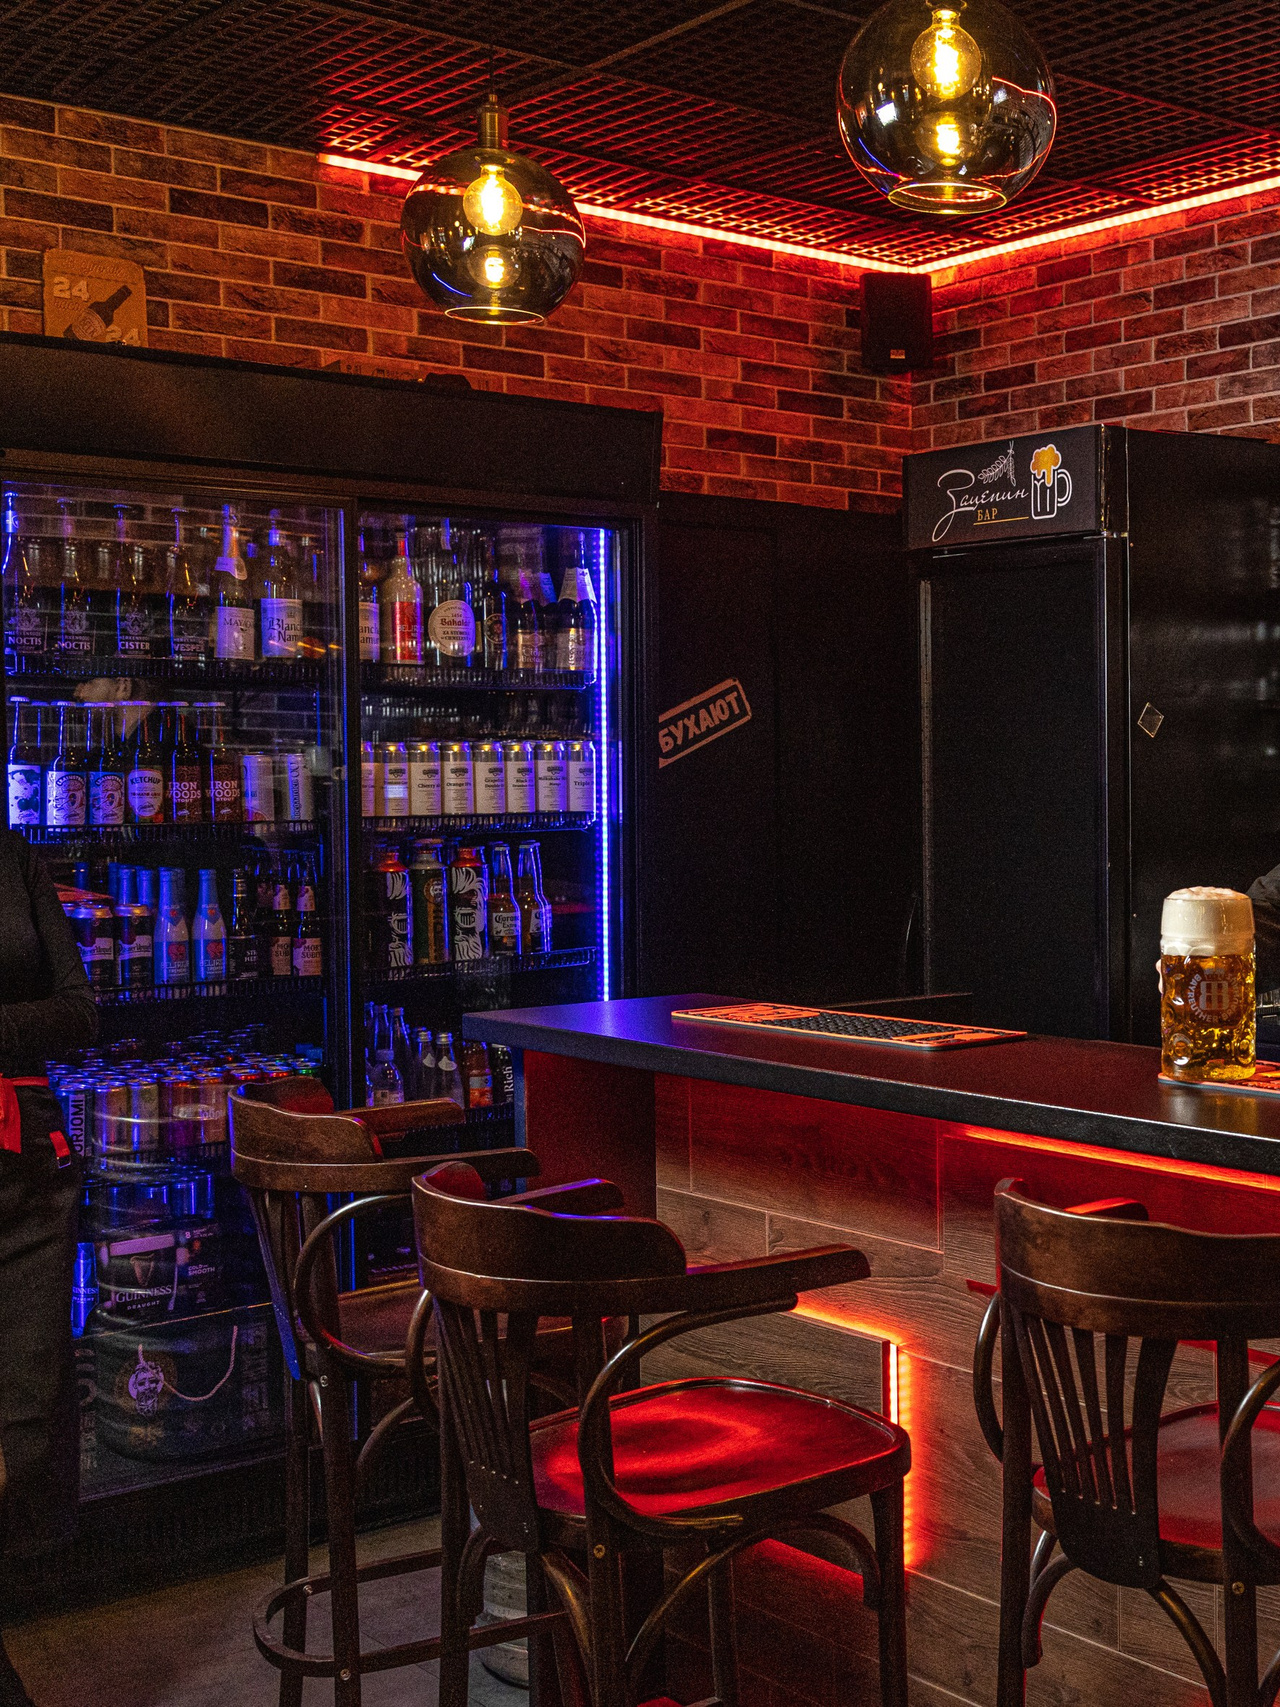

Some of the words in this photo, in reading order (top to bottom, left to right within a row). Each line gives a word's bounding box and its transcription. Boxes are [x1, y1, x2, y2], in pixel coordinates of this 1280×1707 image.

[53, 276, 90, 302] 24
[977, 508, 998, 521] БАР
[8, 636, 42, 646] NOCTIS
[168, 782, 197, 790] IRON
[210, 780, 237, 788] IRON
[504, 1066, 514, 1092] Rich
[115, 1285, 172, 1303] GUINNESS
